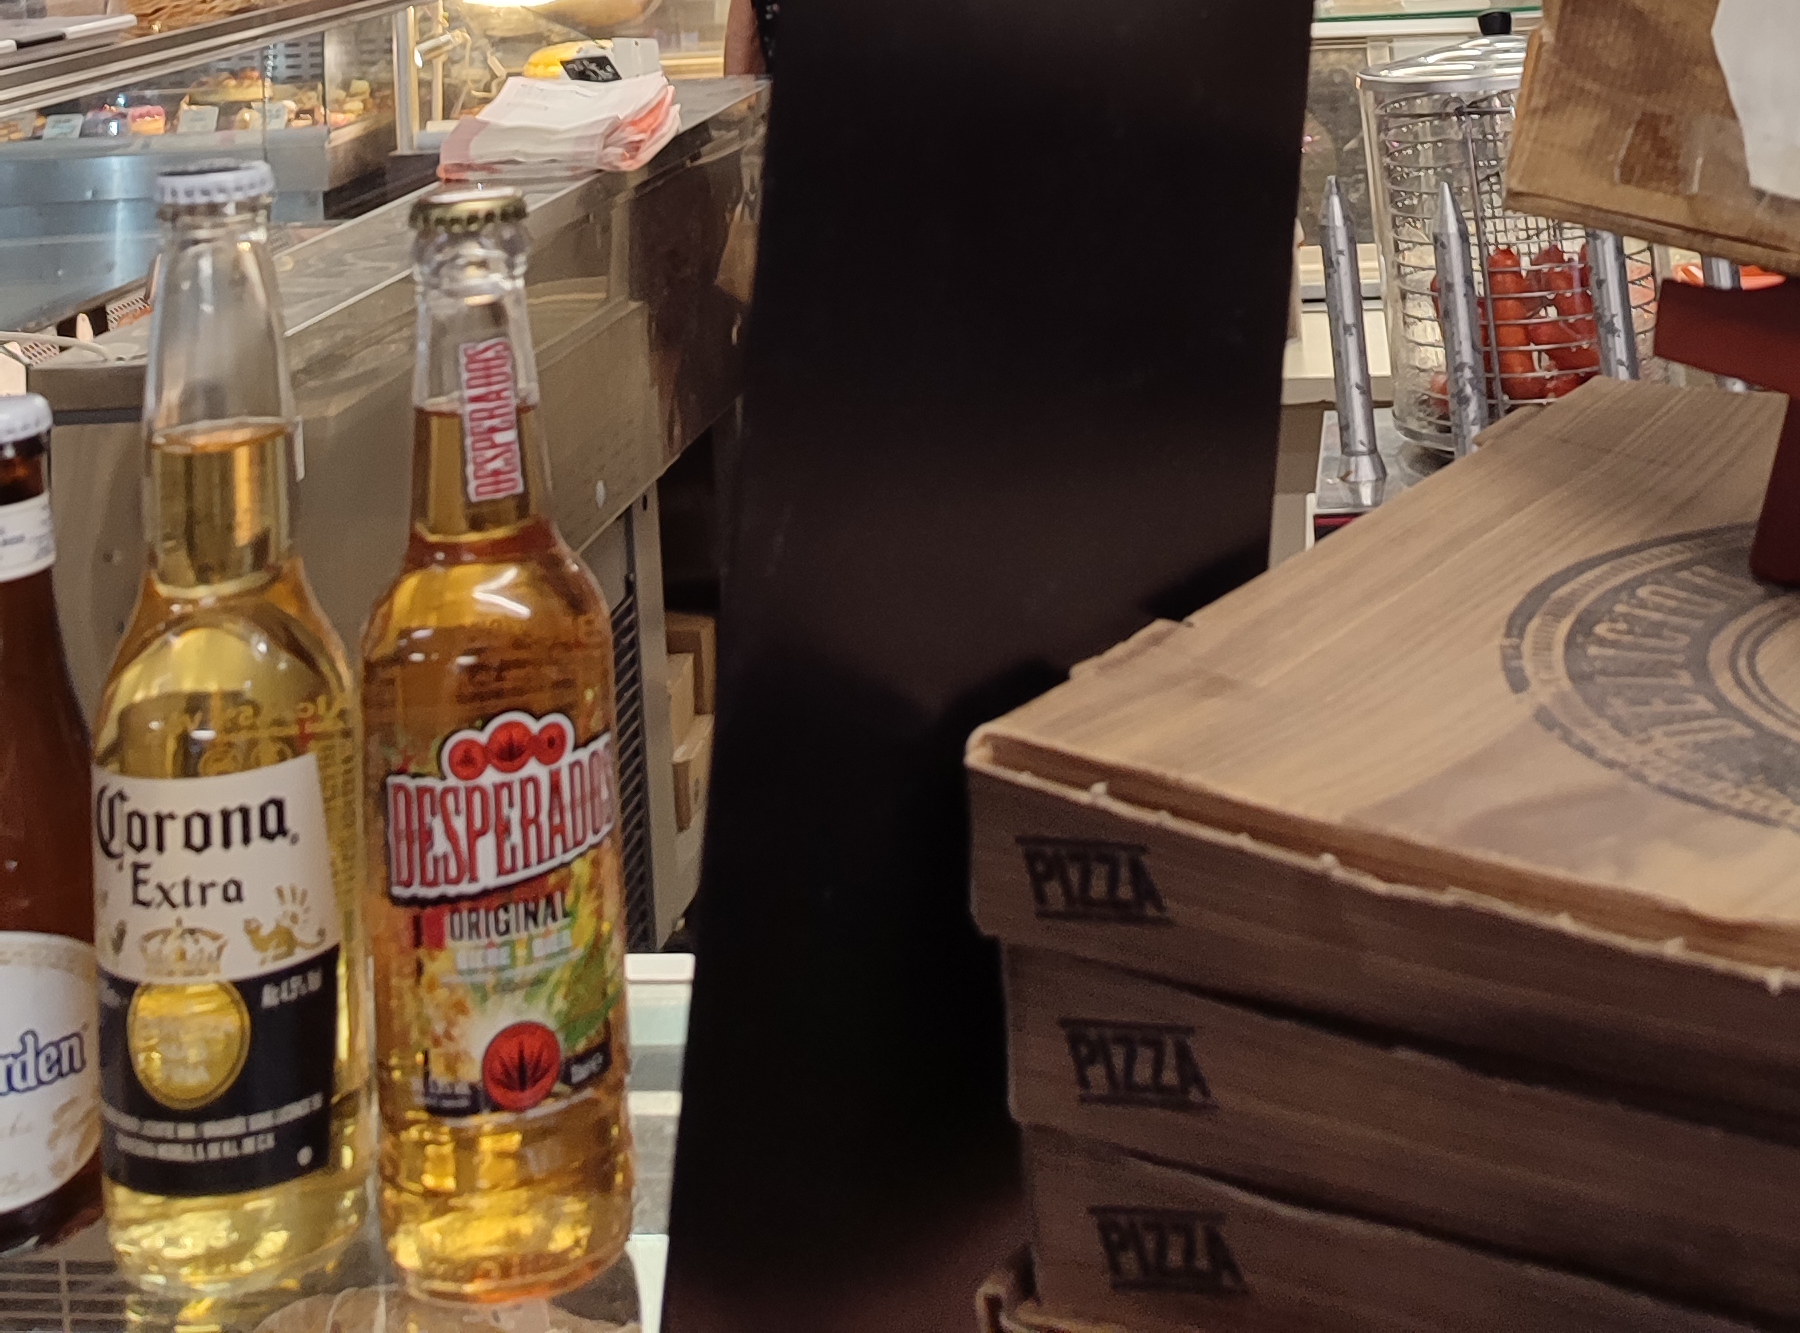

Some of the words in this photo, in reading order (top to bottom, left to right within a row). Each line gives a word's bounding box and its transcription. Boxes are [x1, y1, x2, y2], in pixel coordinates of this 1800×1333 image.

[463, 341, 520, 497] DESPERADOS
[97, 785, 290, 859] Corona
[130, 861, 244, 909] Extra
[1023, 846, 1170, 915] PIZZA
[448, 890, 572, 943] ORIGINAL
[1066, 1032, 1213, 1101] PIZZA
[1097, 1216, 1246, 1288] PIZZA
